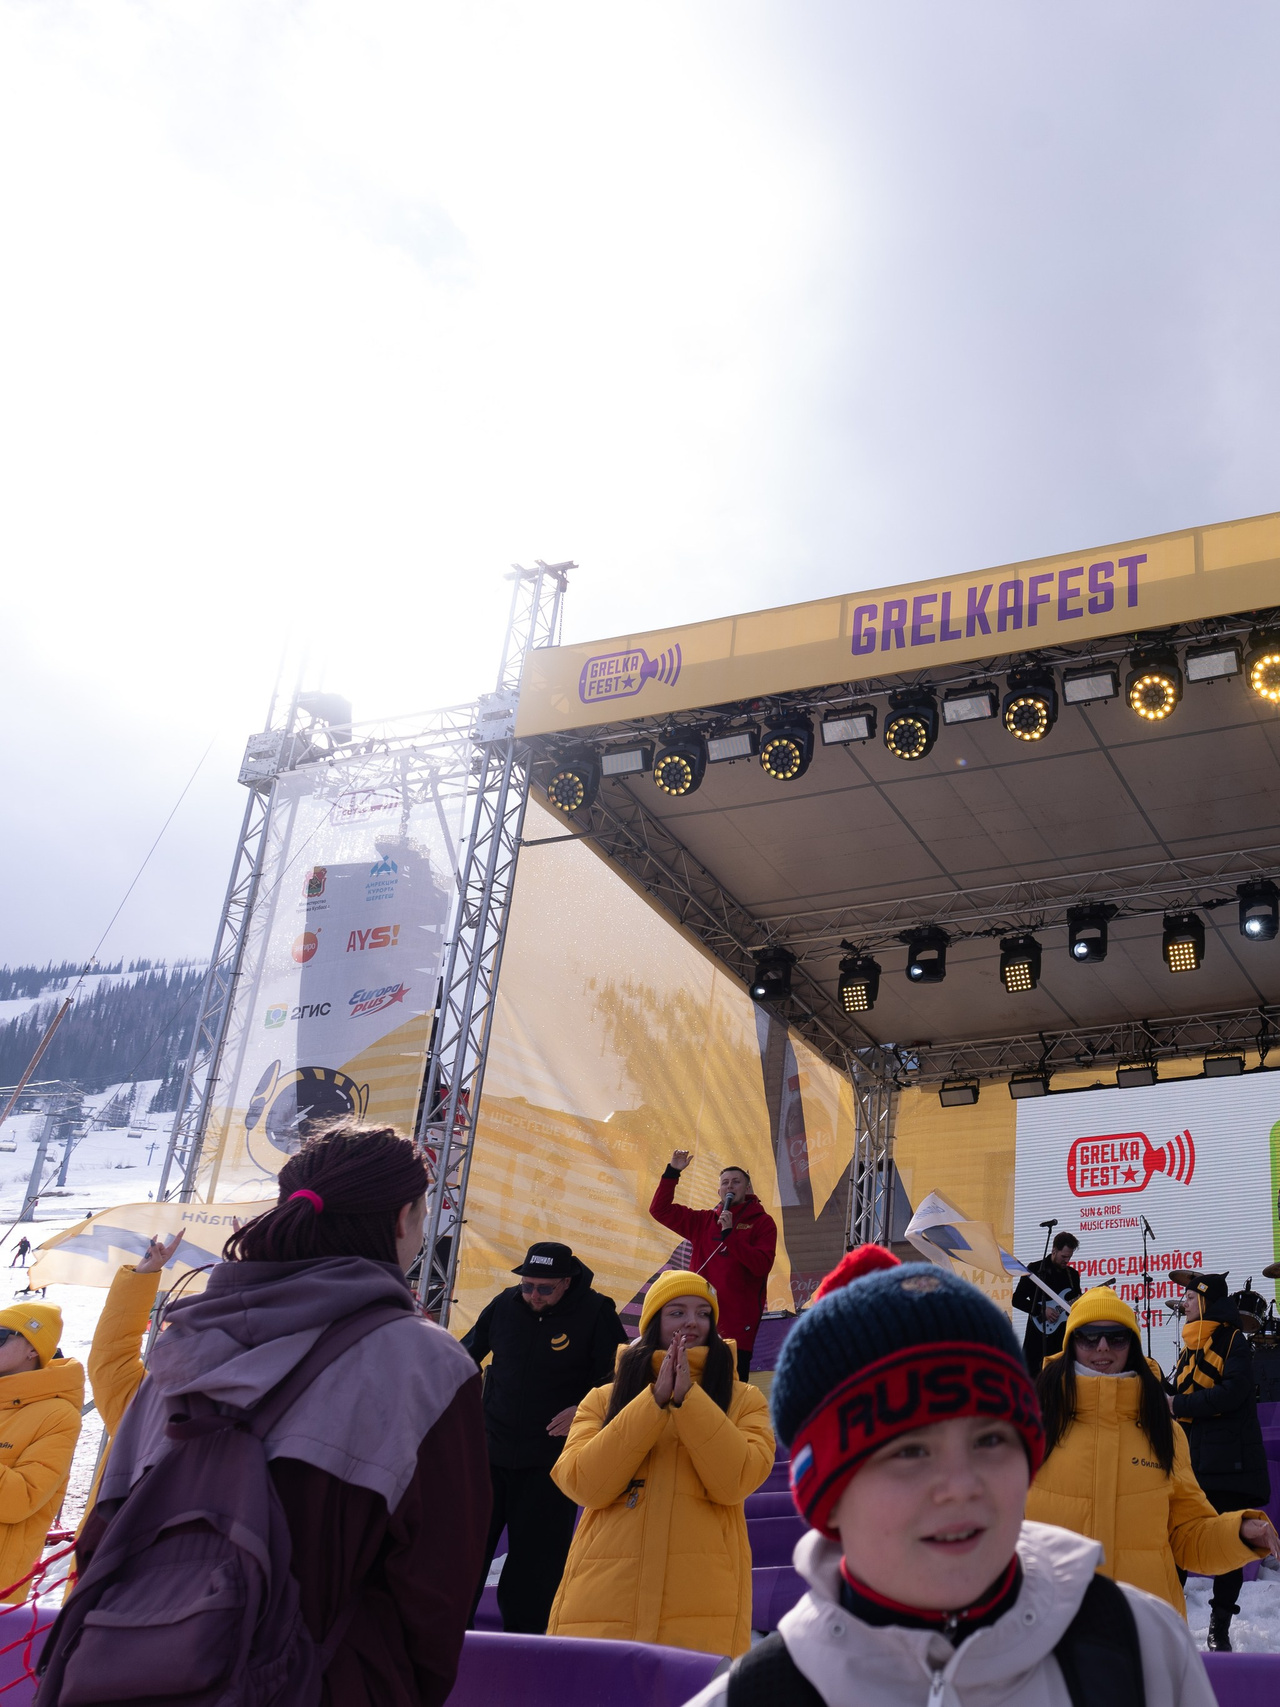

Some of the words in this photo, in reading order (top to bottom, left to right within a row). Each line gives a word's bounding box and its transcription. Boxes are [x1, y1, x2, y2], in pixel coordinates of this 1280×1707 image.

[851, 553, 1147, 656] GRELKAFEST
[590, 656, 639, 678] GRELKA
[588, 676, 621, 697] FEST
[365, 878, 399, 889] ДИРЕКЦИЯ
[367, 886, 394, 895] КУРОРТА
[365, 893, 394, 902] ШЕРЕГЕШ
[346, 924, 401, 953] AYS!
[290, 1001, 332, 1021] 2ГИС
[1080, 1141, 1140, 1165] GRELKA
[1080, 1165, 1120, 1188] FEST
[1080, 1207, 1095, 1217] SUN
[1096, 1207, 1103, 1216] &
[1104, 1205, 1121, 1215] RIDE
[1080, 1220, 1104, 1231] MUSIC
[1105, 1217, 1139, 1229] FESTIVAL
[1067, 1250, 1202, 1277] ПРИСОЕДИНЯЙСЯ
[837, 1364, 1044, 1453] RUSSIA
